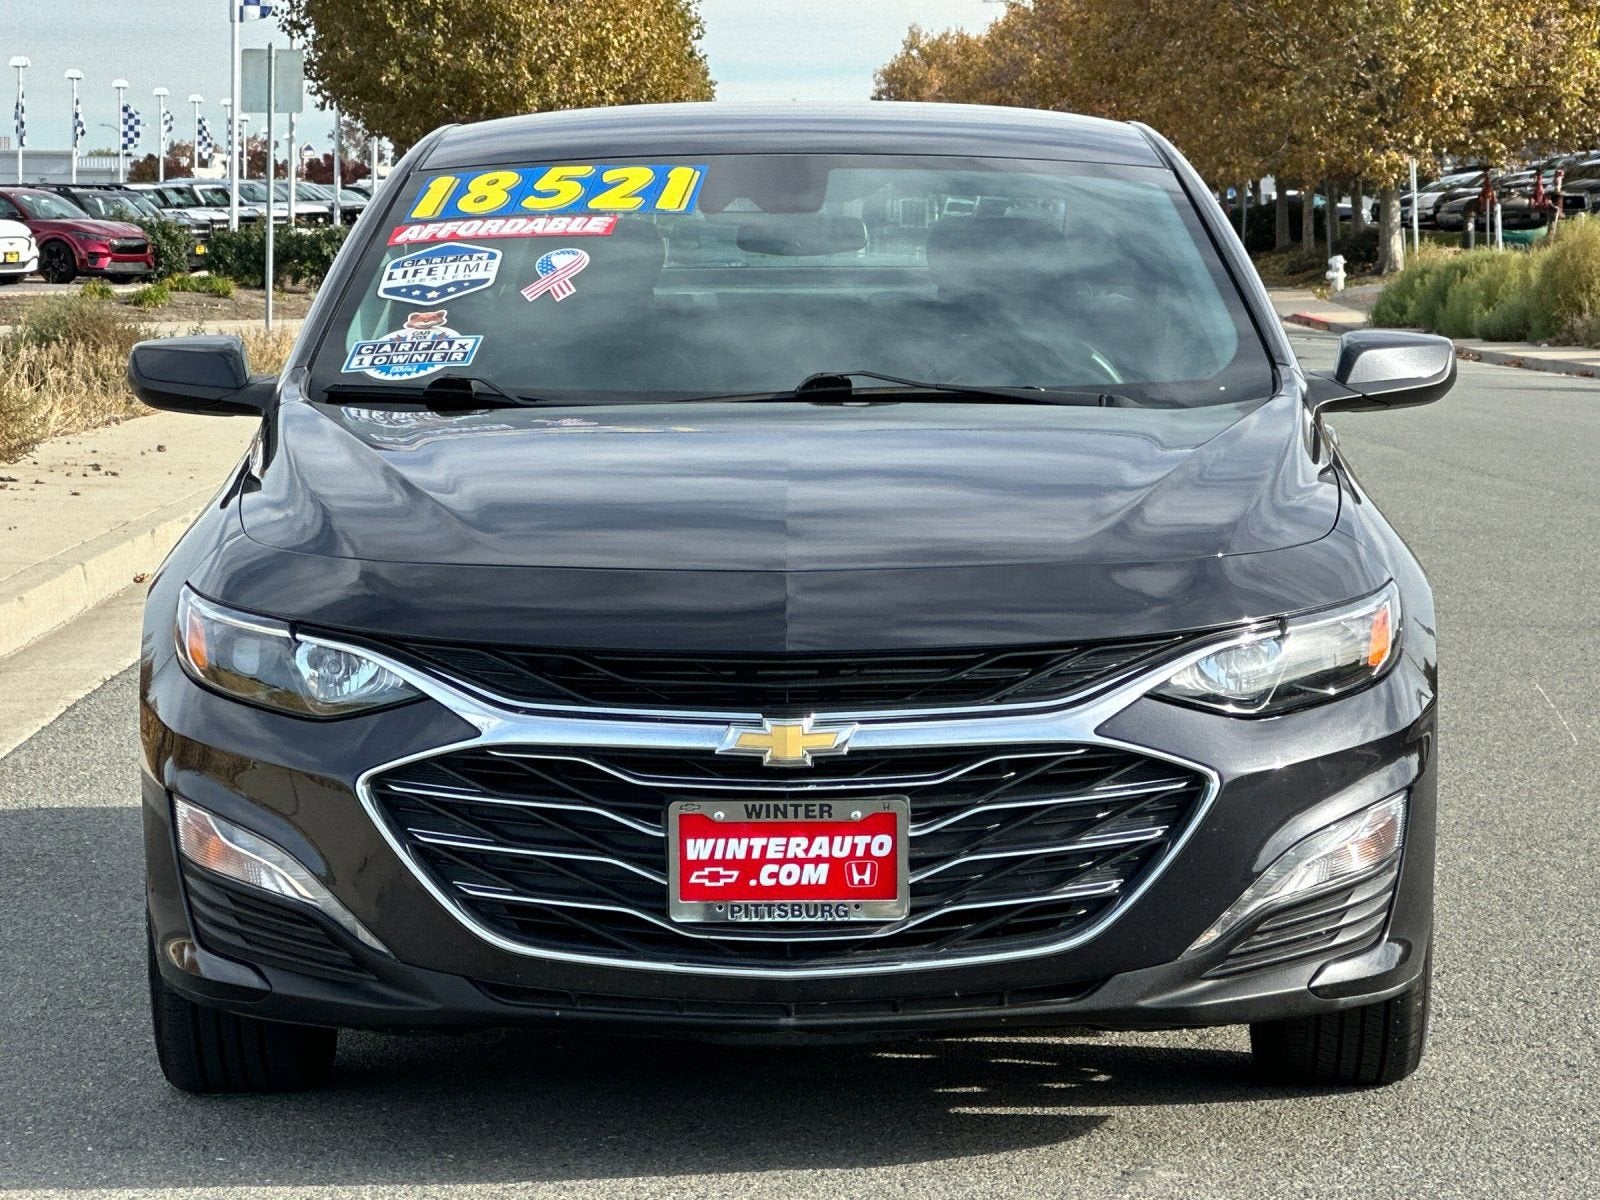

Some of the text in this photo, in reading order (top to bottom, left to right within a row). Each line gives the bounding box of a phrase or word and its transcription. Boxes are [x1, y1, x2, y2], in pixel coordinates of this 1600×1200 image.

[411, 165, 700, 219] 18521
[393, 216, 611, 243] AFFORDABLE
[401, 254, 487, 267] CARFAX
[386, 262, 494, 281] LIFETIME
[407, 274, 471, 284] DEALER
[360, 341, 469, 355] CARFAX
[354, 352, 464, 367] 1 OWNER
[744, 803, 833, 819] WINTER
[686, 834, 893, 860] WINTERAUTO
[749, 863, 829, 886] .COM
[729, 903, 849, 919] PITTSBURG
